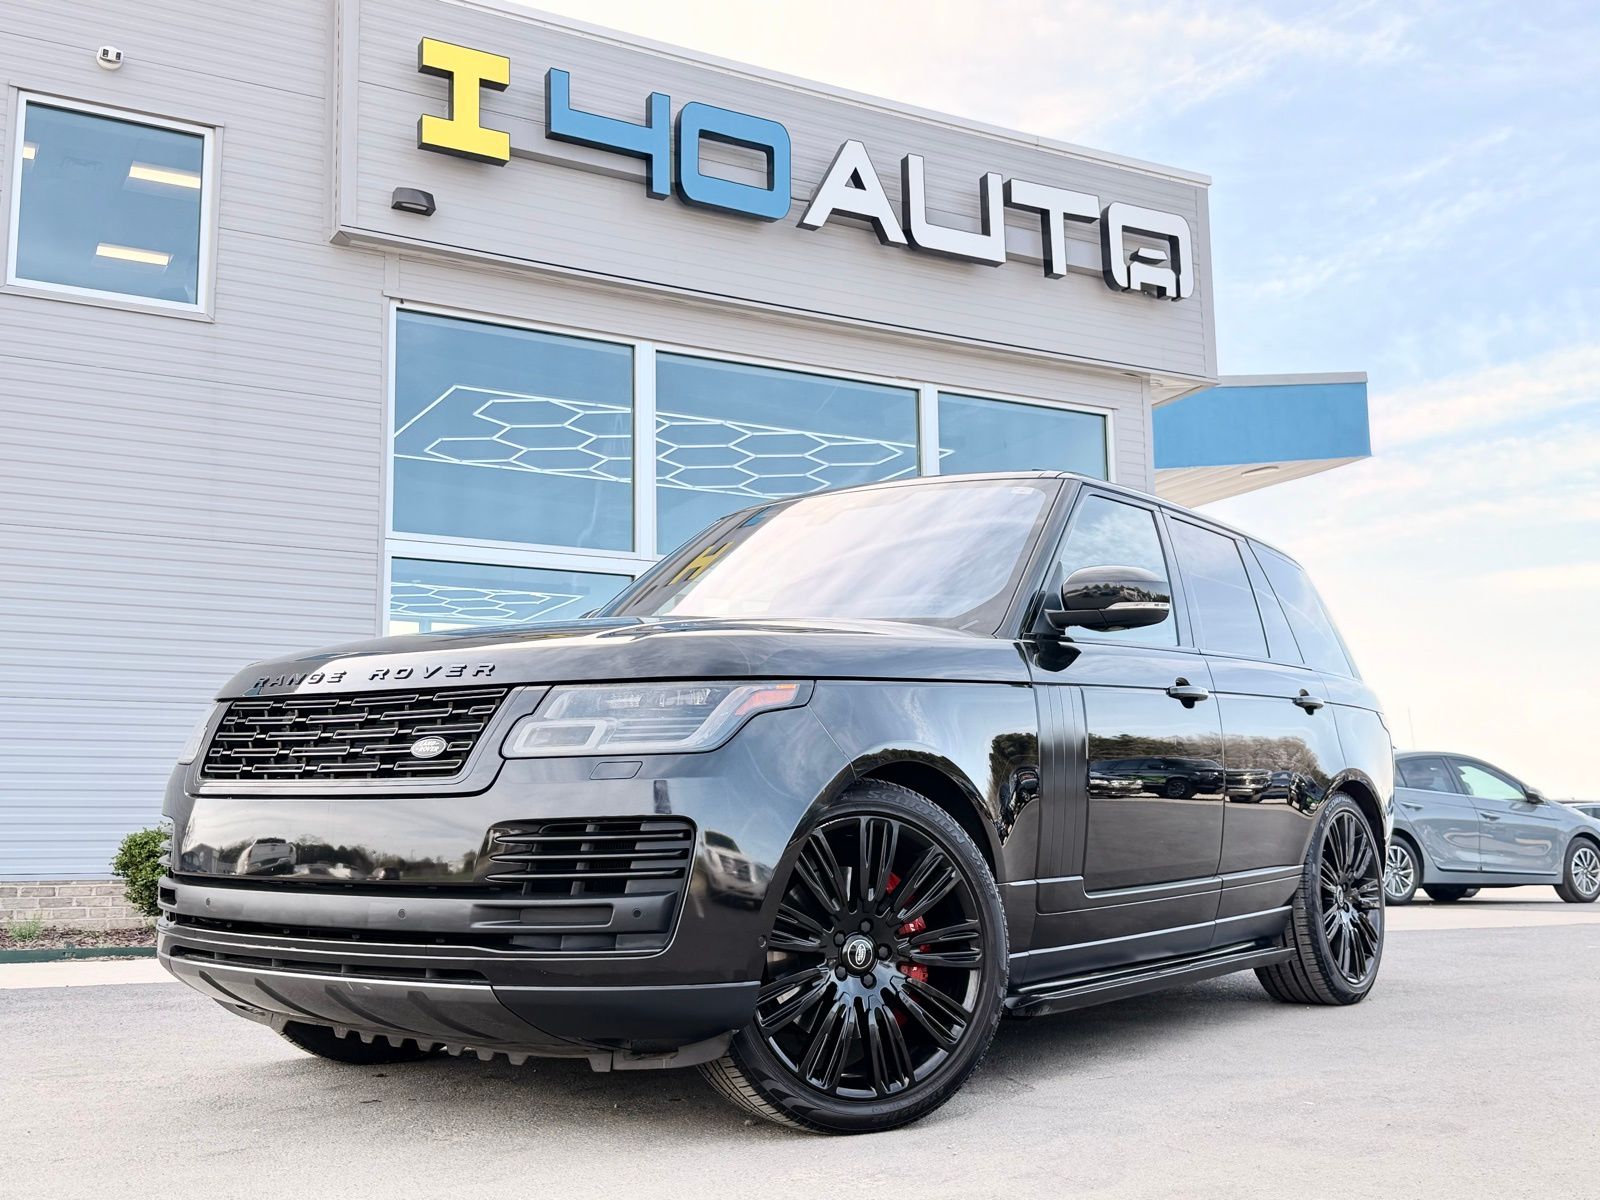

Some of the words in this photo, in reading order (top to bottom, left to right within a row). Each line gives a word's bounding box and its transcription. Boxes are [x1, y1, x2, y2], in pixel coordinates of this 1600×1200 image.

[798, 139, 1195, 301] AUTO
[252, 671, 347, 689] RANGE
[368, 663, 496, 680] ROVER
